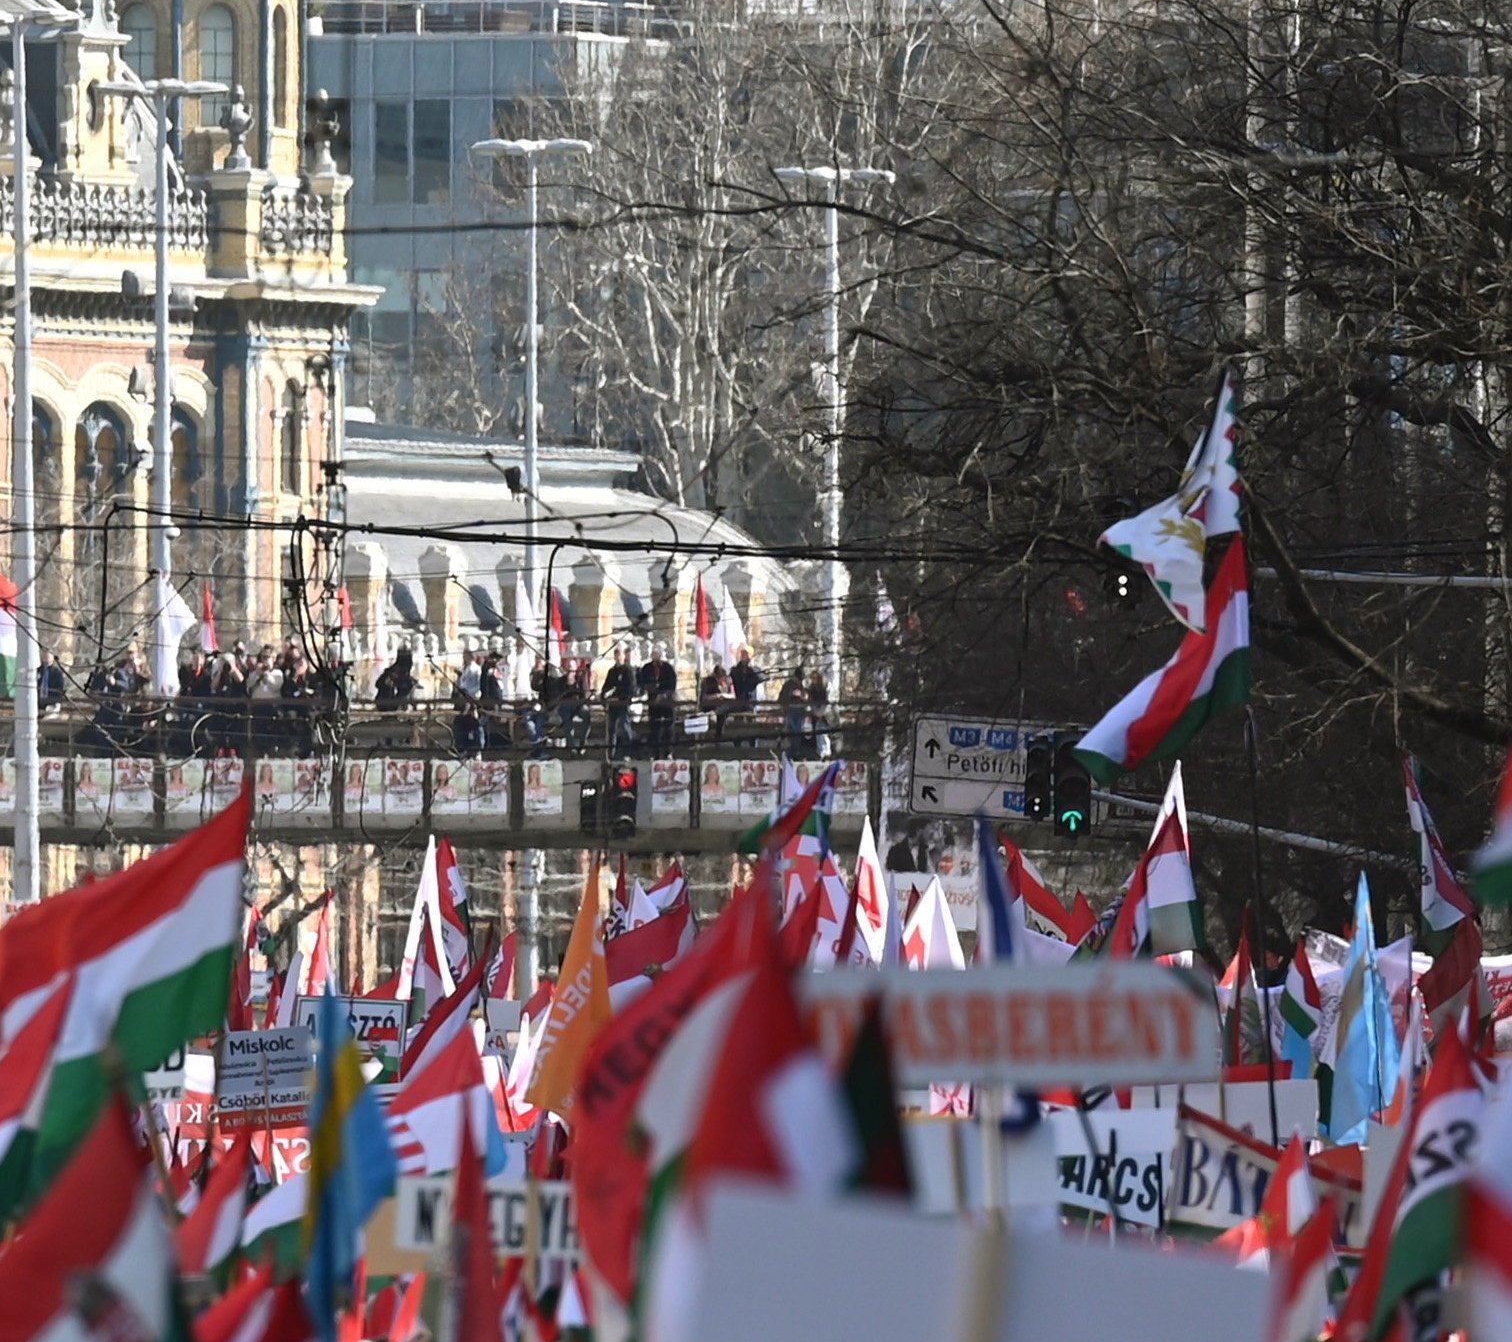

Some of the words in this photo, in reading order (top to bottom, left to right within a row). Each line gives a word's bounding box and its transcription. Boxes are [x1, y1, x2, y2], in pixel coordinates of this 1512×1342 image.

[953, 730, 976, 743] M3
[991, 733, 1013, 745] M4
[1010, 760, 1026, 775] hi
[229, 1035, 295, 1055] Miskolc
[1061, 1154, 1160, 1212] ARCS
